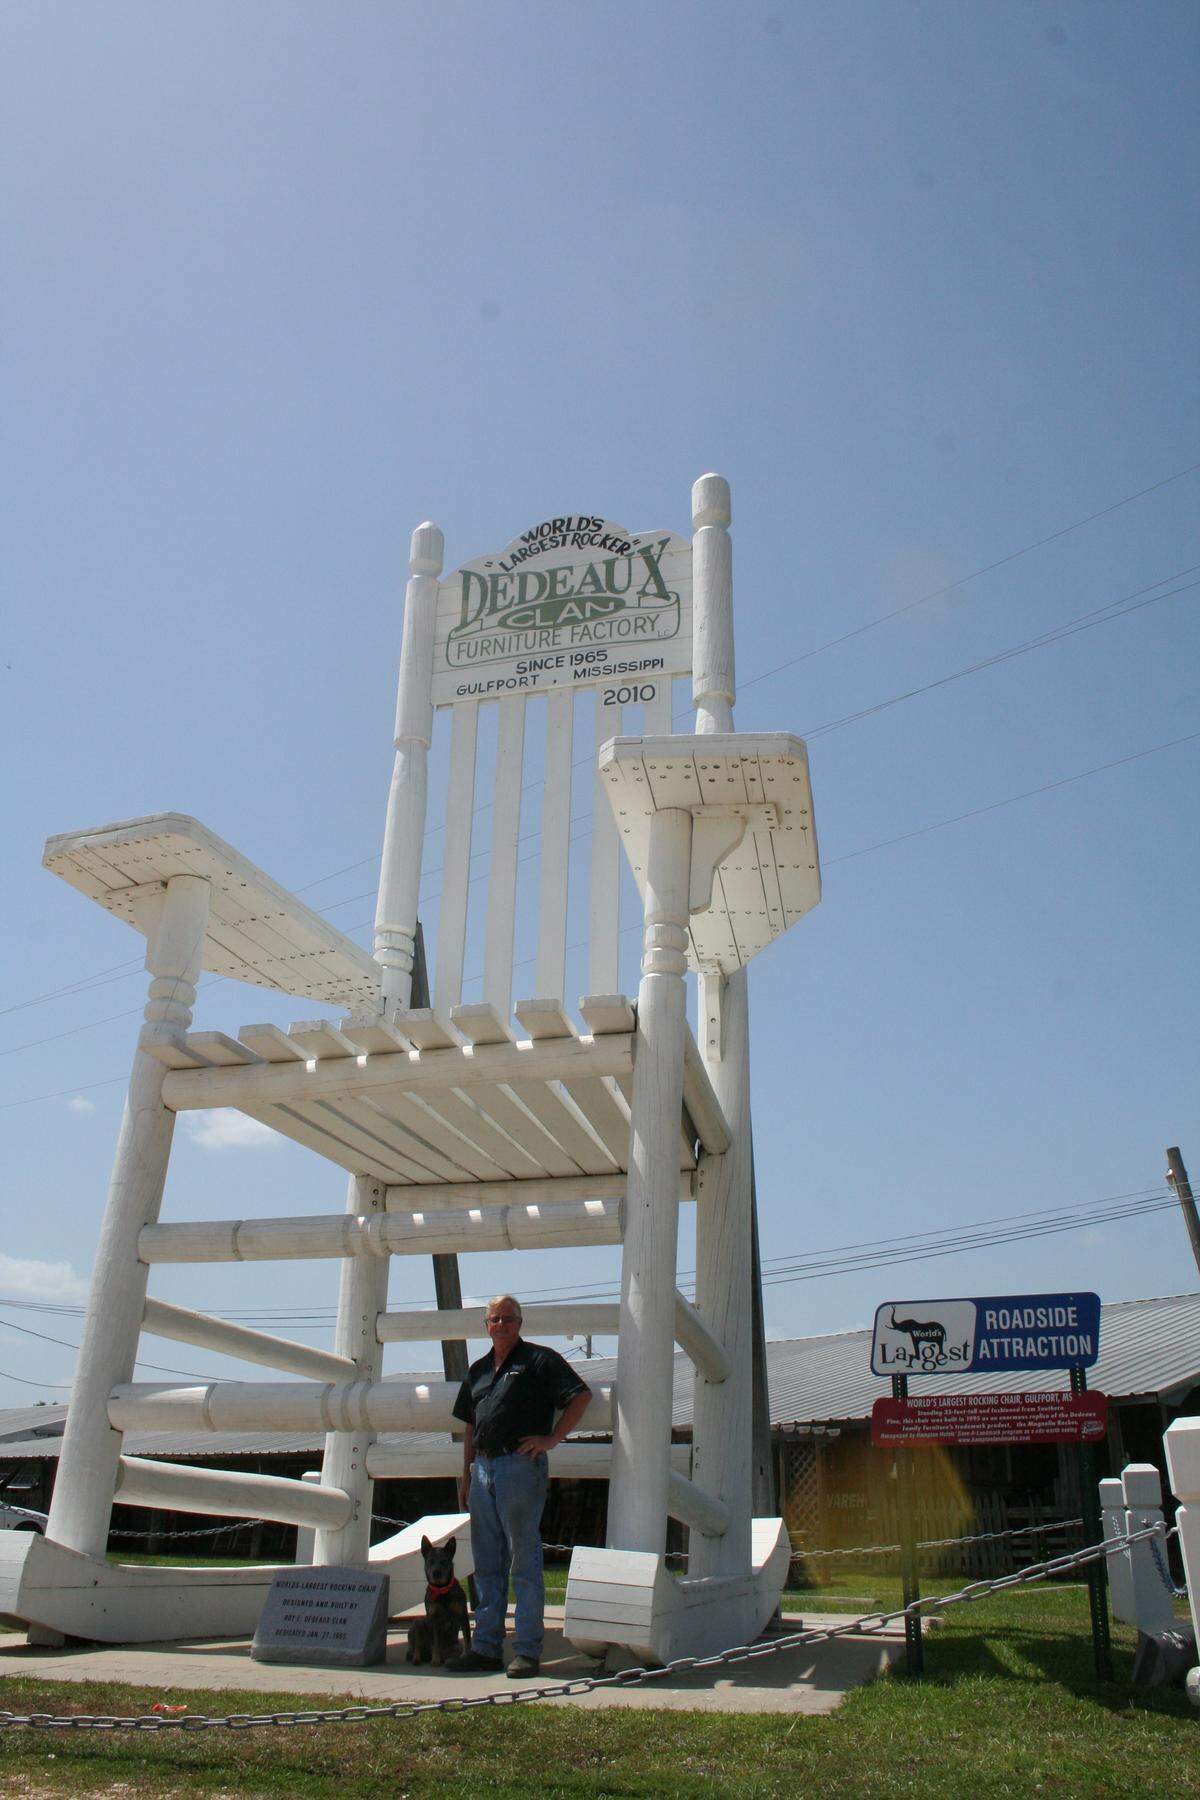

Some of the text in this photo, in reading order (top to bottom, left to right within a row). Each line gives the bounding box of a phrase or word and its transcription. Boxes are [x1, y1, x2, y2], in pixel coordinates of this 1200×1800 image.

[520, 516, 605, 544] WORLD'S
[455, 536, 672, 632] DEDEAUX
[506, 601, 615, 628] CLAN
[457, 628, 562, 660] FURNITURE
[570, 613, 660, 643] FACTORY
[516, 650, 608, 675] SINCE 1965
[573, 658, 664, 680] MISSISSIPPI
[603, 685, 656, 706] 2010
[985, 1306, 1079, 1330] ROADSIDE
[912, 1329, 943, 1339] World's
[880, 1342, 971, 1371] Largest
[978, 1335, 1093, 1359] ATTRACTION
[907, 1393, 1073, 1408] WORLD'S LARGEST ROCKING CHAIR, GULFPORT, MS
